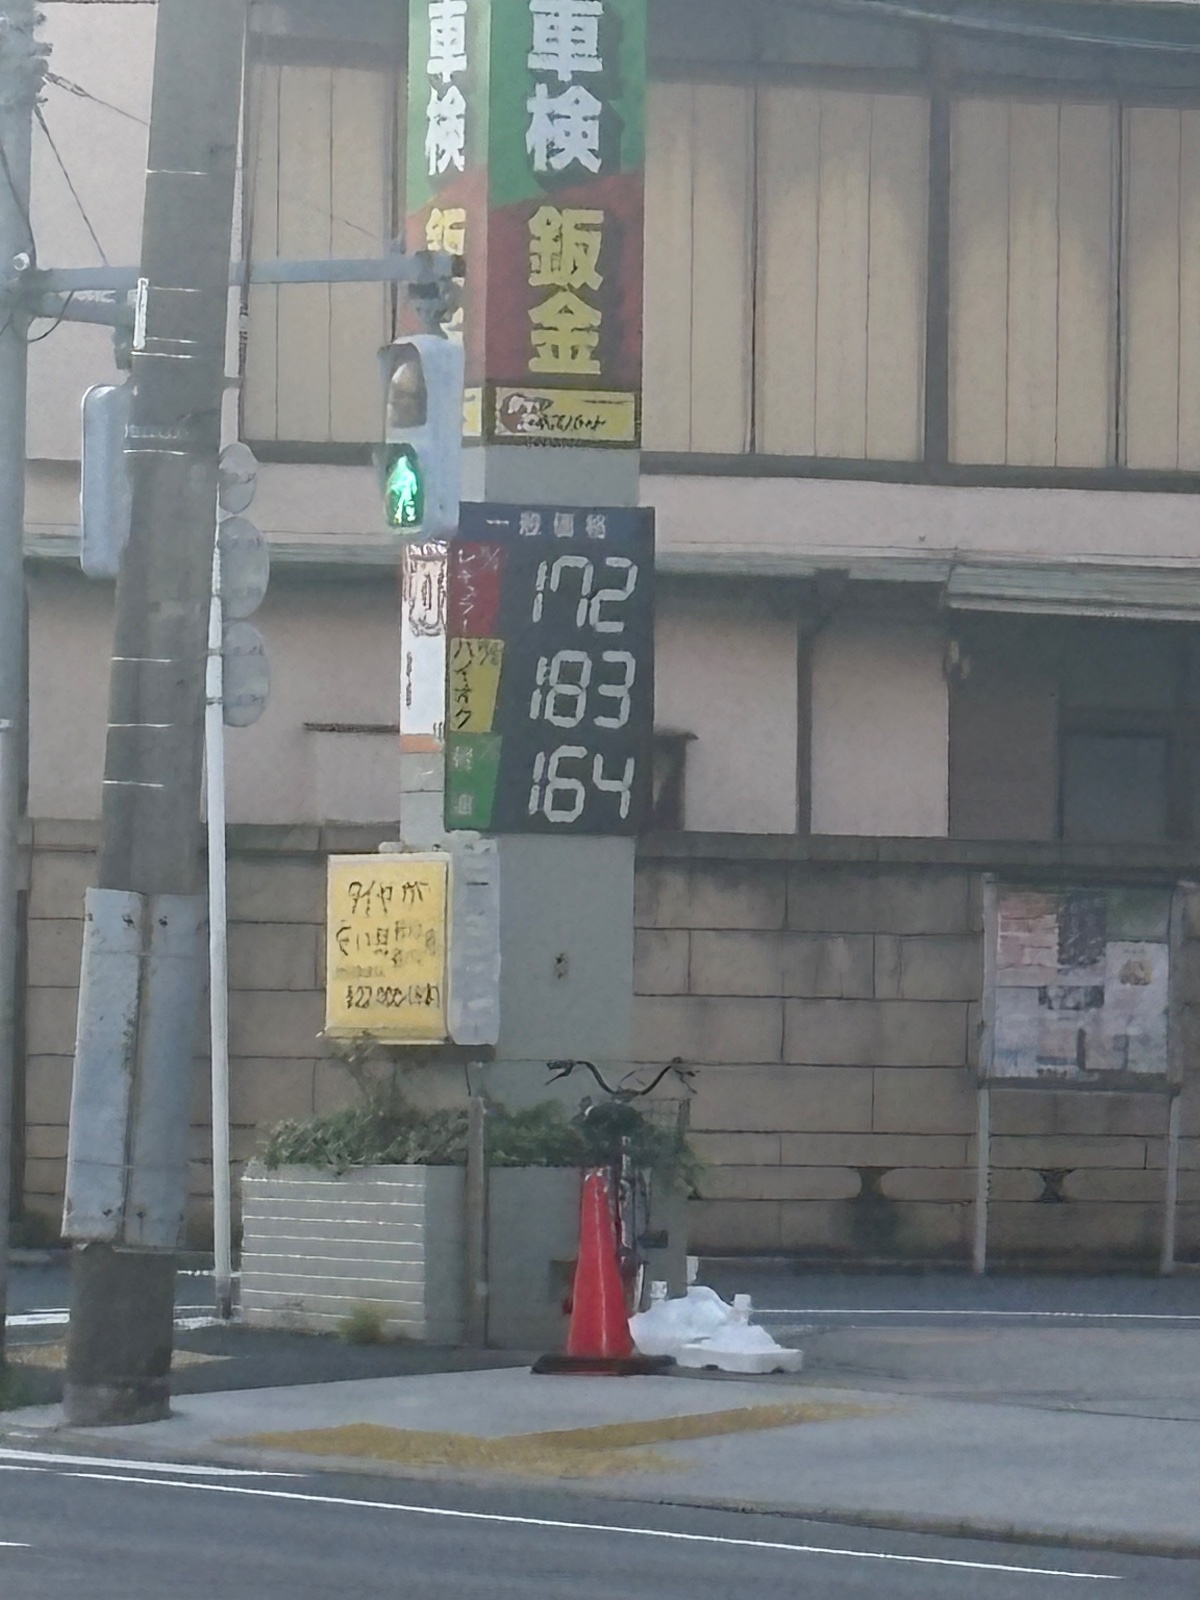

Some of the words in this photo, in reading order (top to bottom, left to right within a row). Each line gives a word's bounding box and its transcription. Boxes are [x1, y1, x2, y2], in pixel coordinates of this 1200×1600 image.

[526, 0, 604, 174] 車検
[528, 206, 604, 374] 鈑金
[532, 555, 638, 633] 172
[529, 650, 636, 729] 183
[528, 745, 635, 822] 164
